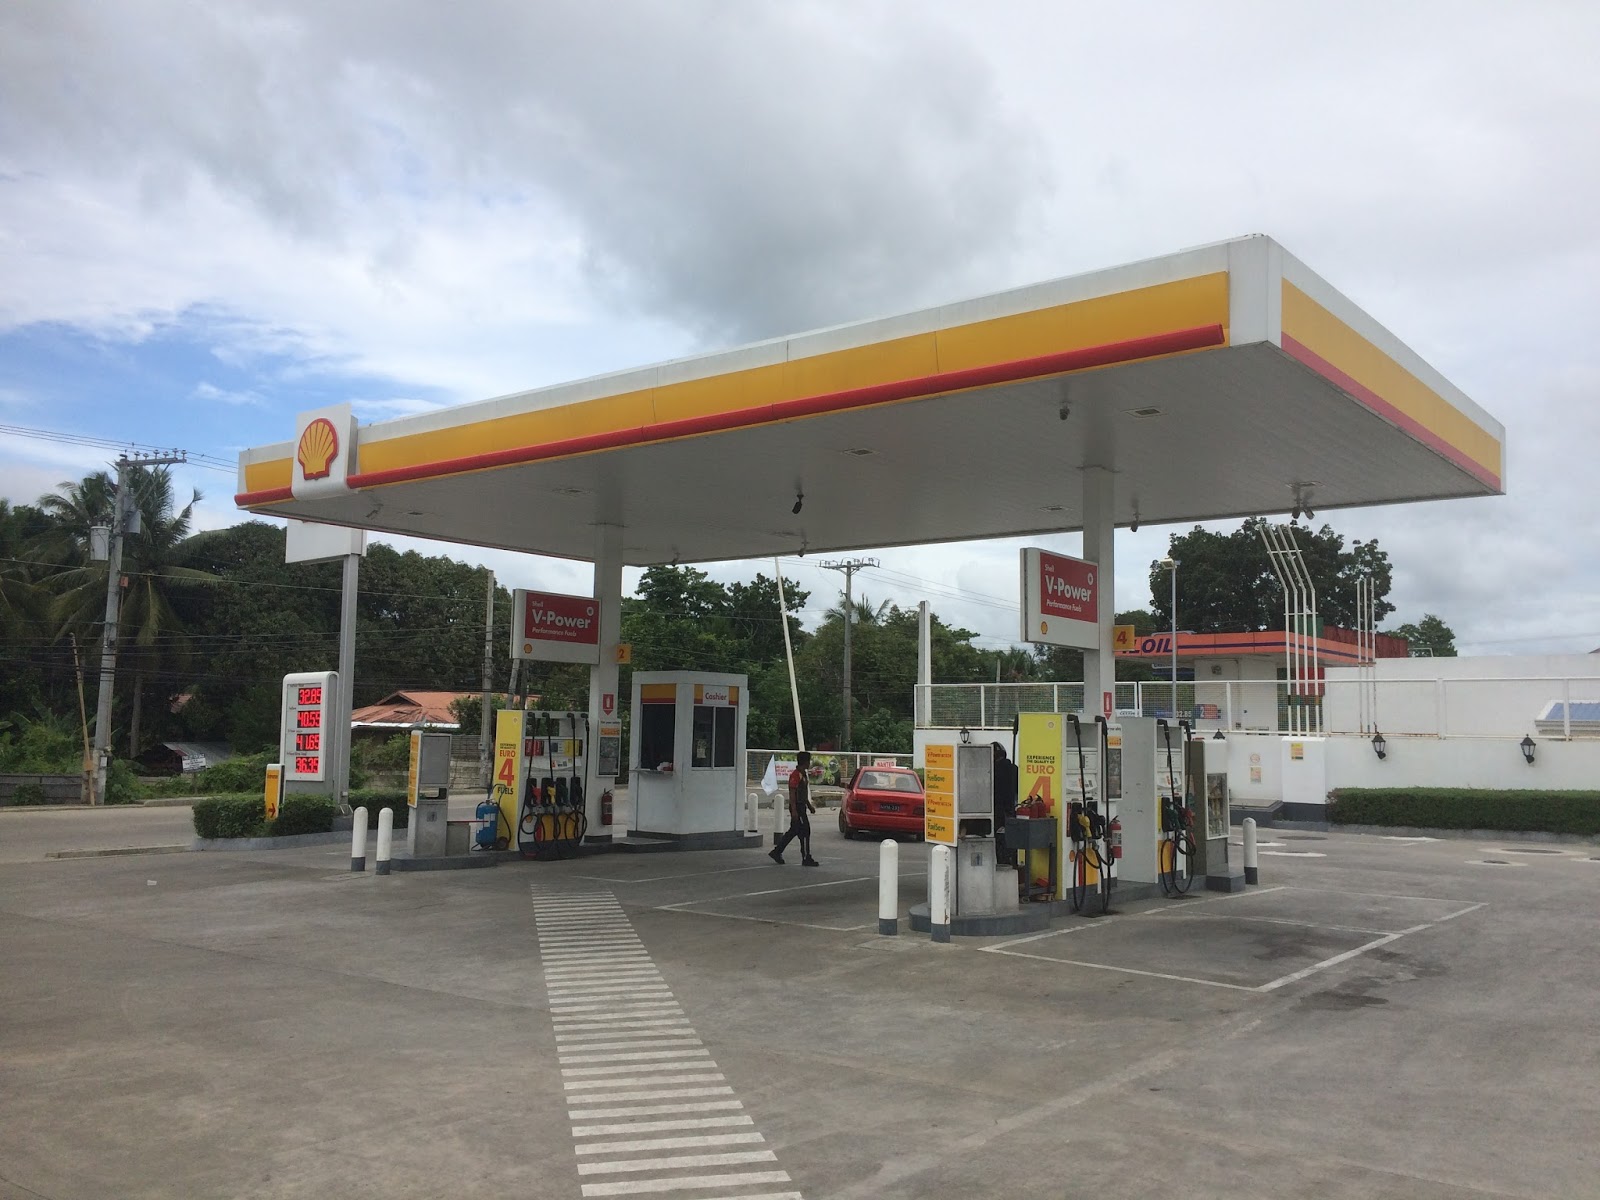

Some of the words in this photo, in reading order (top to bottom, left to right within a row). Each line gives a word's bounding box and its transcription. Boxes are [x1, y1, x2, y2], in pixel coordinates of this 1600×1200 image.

[1044, 563, 1055, 573] Shell
[1044, 574, 1092, 602] V-Power
[1046, 599, 1071, 611] Performance
[1072, 604, 1082, 613] Fuels
[532, 609, 591, 629] V-Power
[531, 627, 564, 636] Performance
[1116, 630, 1128, 645] 4
[618, 648, 625, 659] 2
[704, 692, 728, 701] Cashier
[499, 749, 516, 758] EURO
[498, 758, 515, 787] 4
[1026, 765, 1055, 775] EURO
[497, 786, 514, 795] FUELS
[1027, 776, 1055, 814] 4
